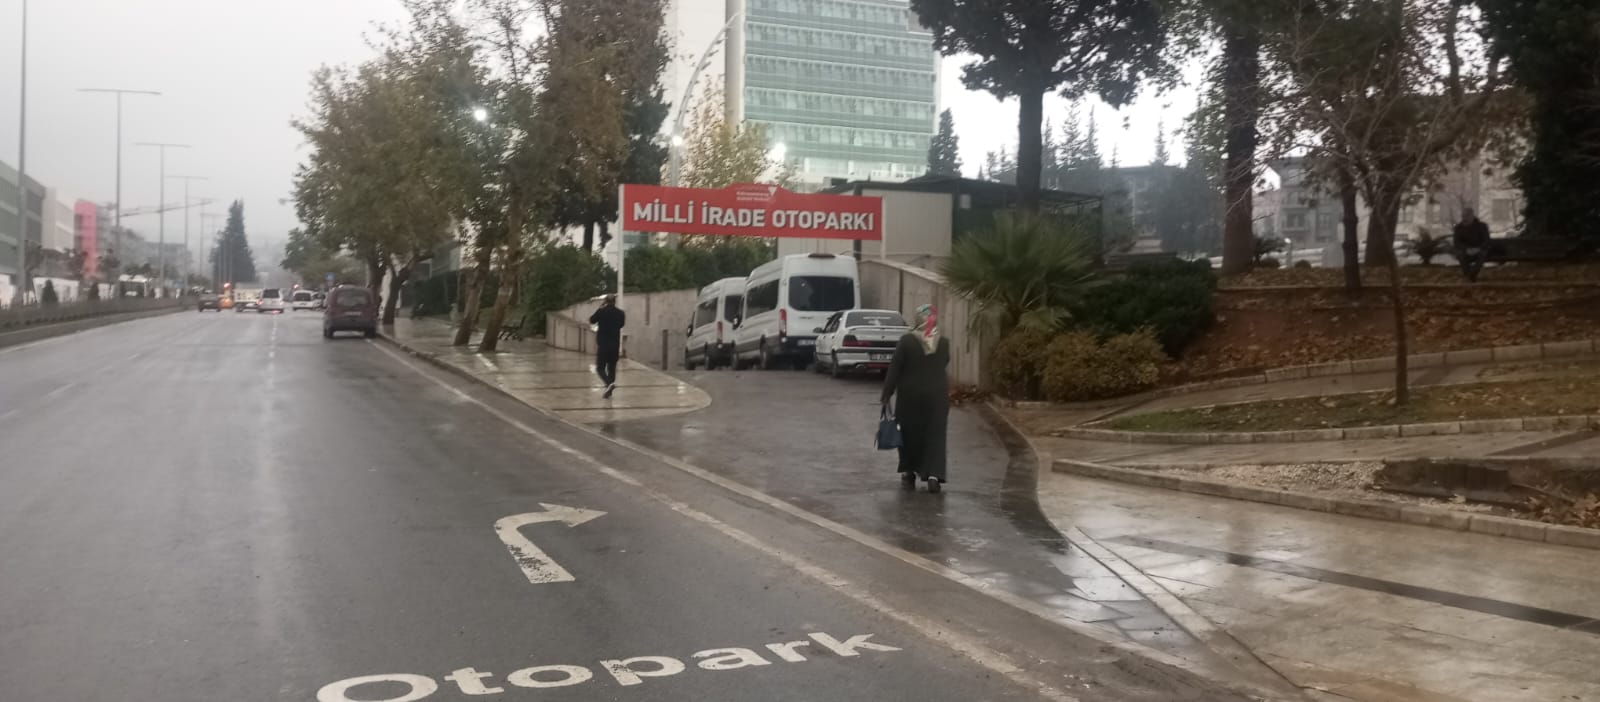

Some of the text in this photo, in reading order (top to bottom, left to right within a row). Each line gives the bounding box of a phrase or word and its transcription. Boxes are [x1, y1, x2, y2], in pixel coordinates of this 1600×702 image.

[633, 198, 874, 231] MİLLİ İRADE OTOPARKI
[316, 632, 902, 702] Otopark
